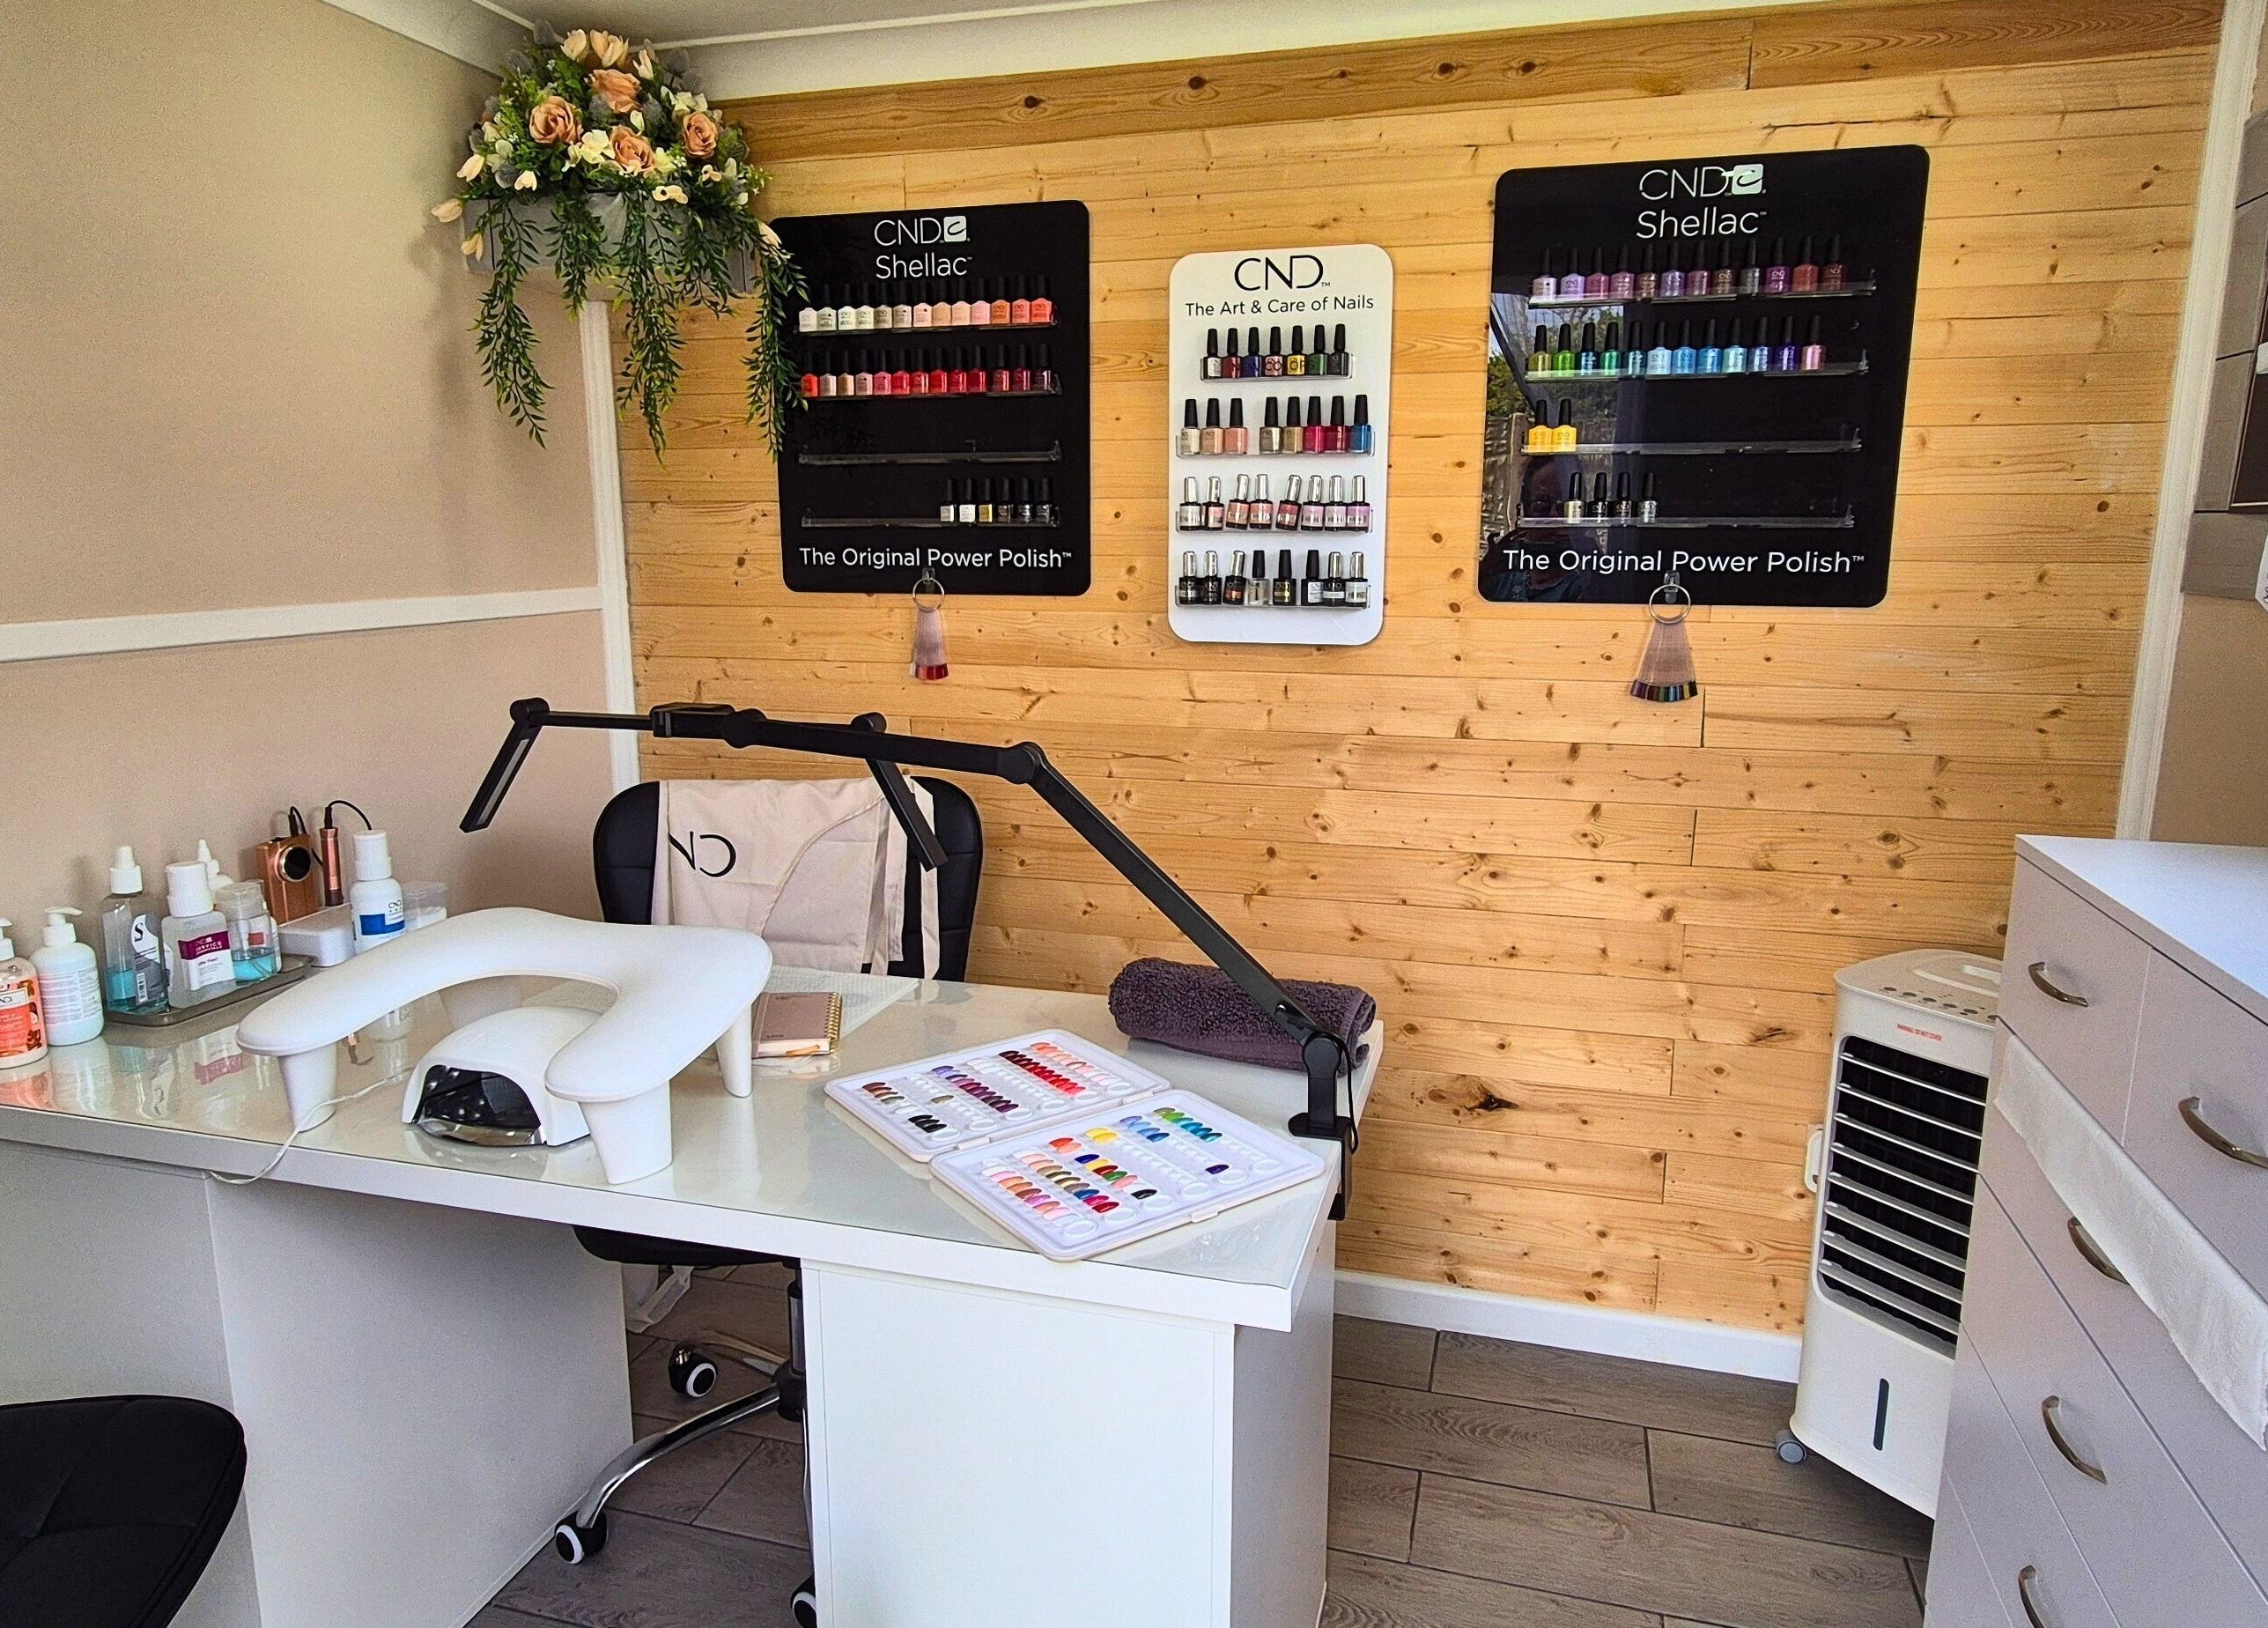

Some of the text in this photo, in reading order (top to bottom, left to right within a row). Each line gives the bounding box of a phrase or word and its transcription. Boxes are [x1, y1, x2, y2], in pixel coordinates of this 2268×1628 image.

[1636, 206, 1759, 239] Shellac
[876, 252, 967, 278] Shellac
[1186, 295, 1374, 316] The Art & Care of Nails
[800, 547, 836, 566] The
[842, 547, 920, 569] Original
[927, 548, 993, 566] Power
[1503, 549, 1550, 570] The
[1559, 549, 1662, 574] Original
[1673, 551, 1758, 572] Power
[669, 831, 736, 878] ND
